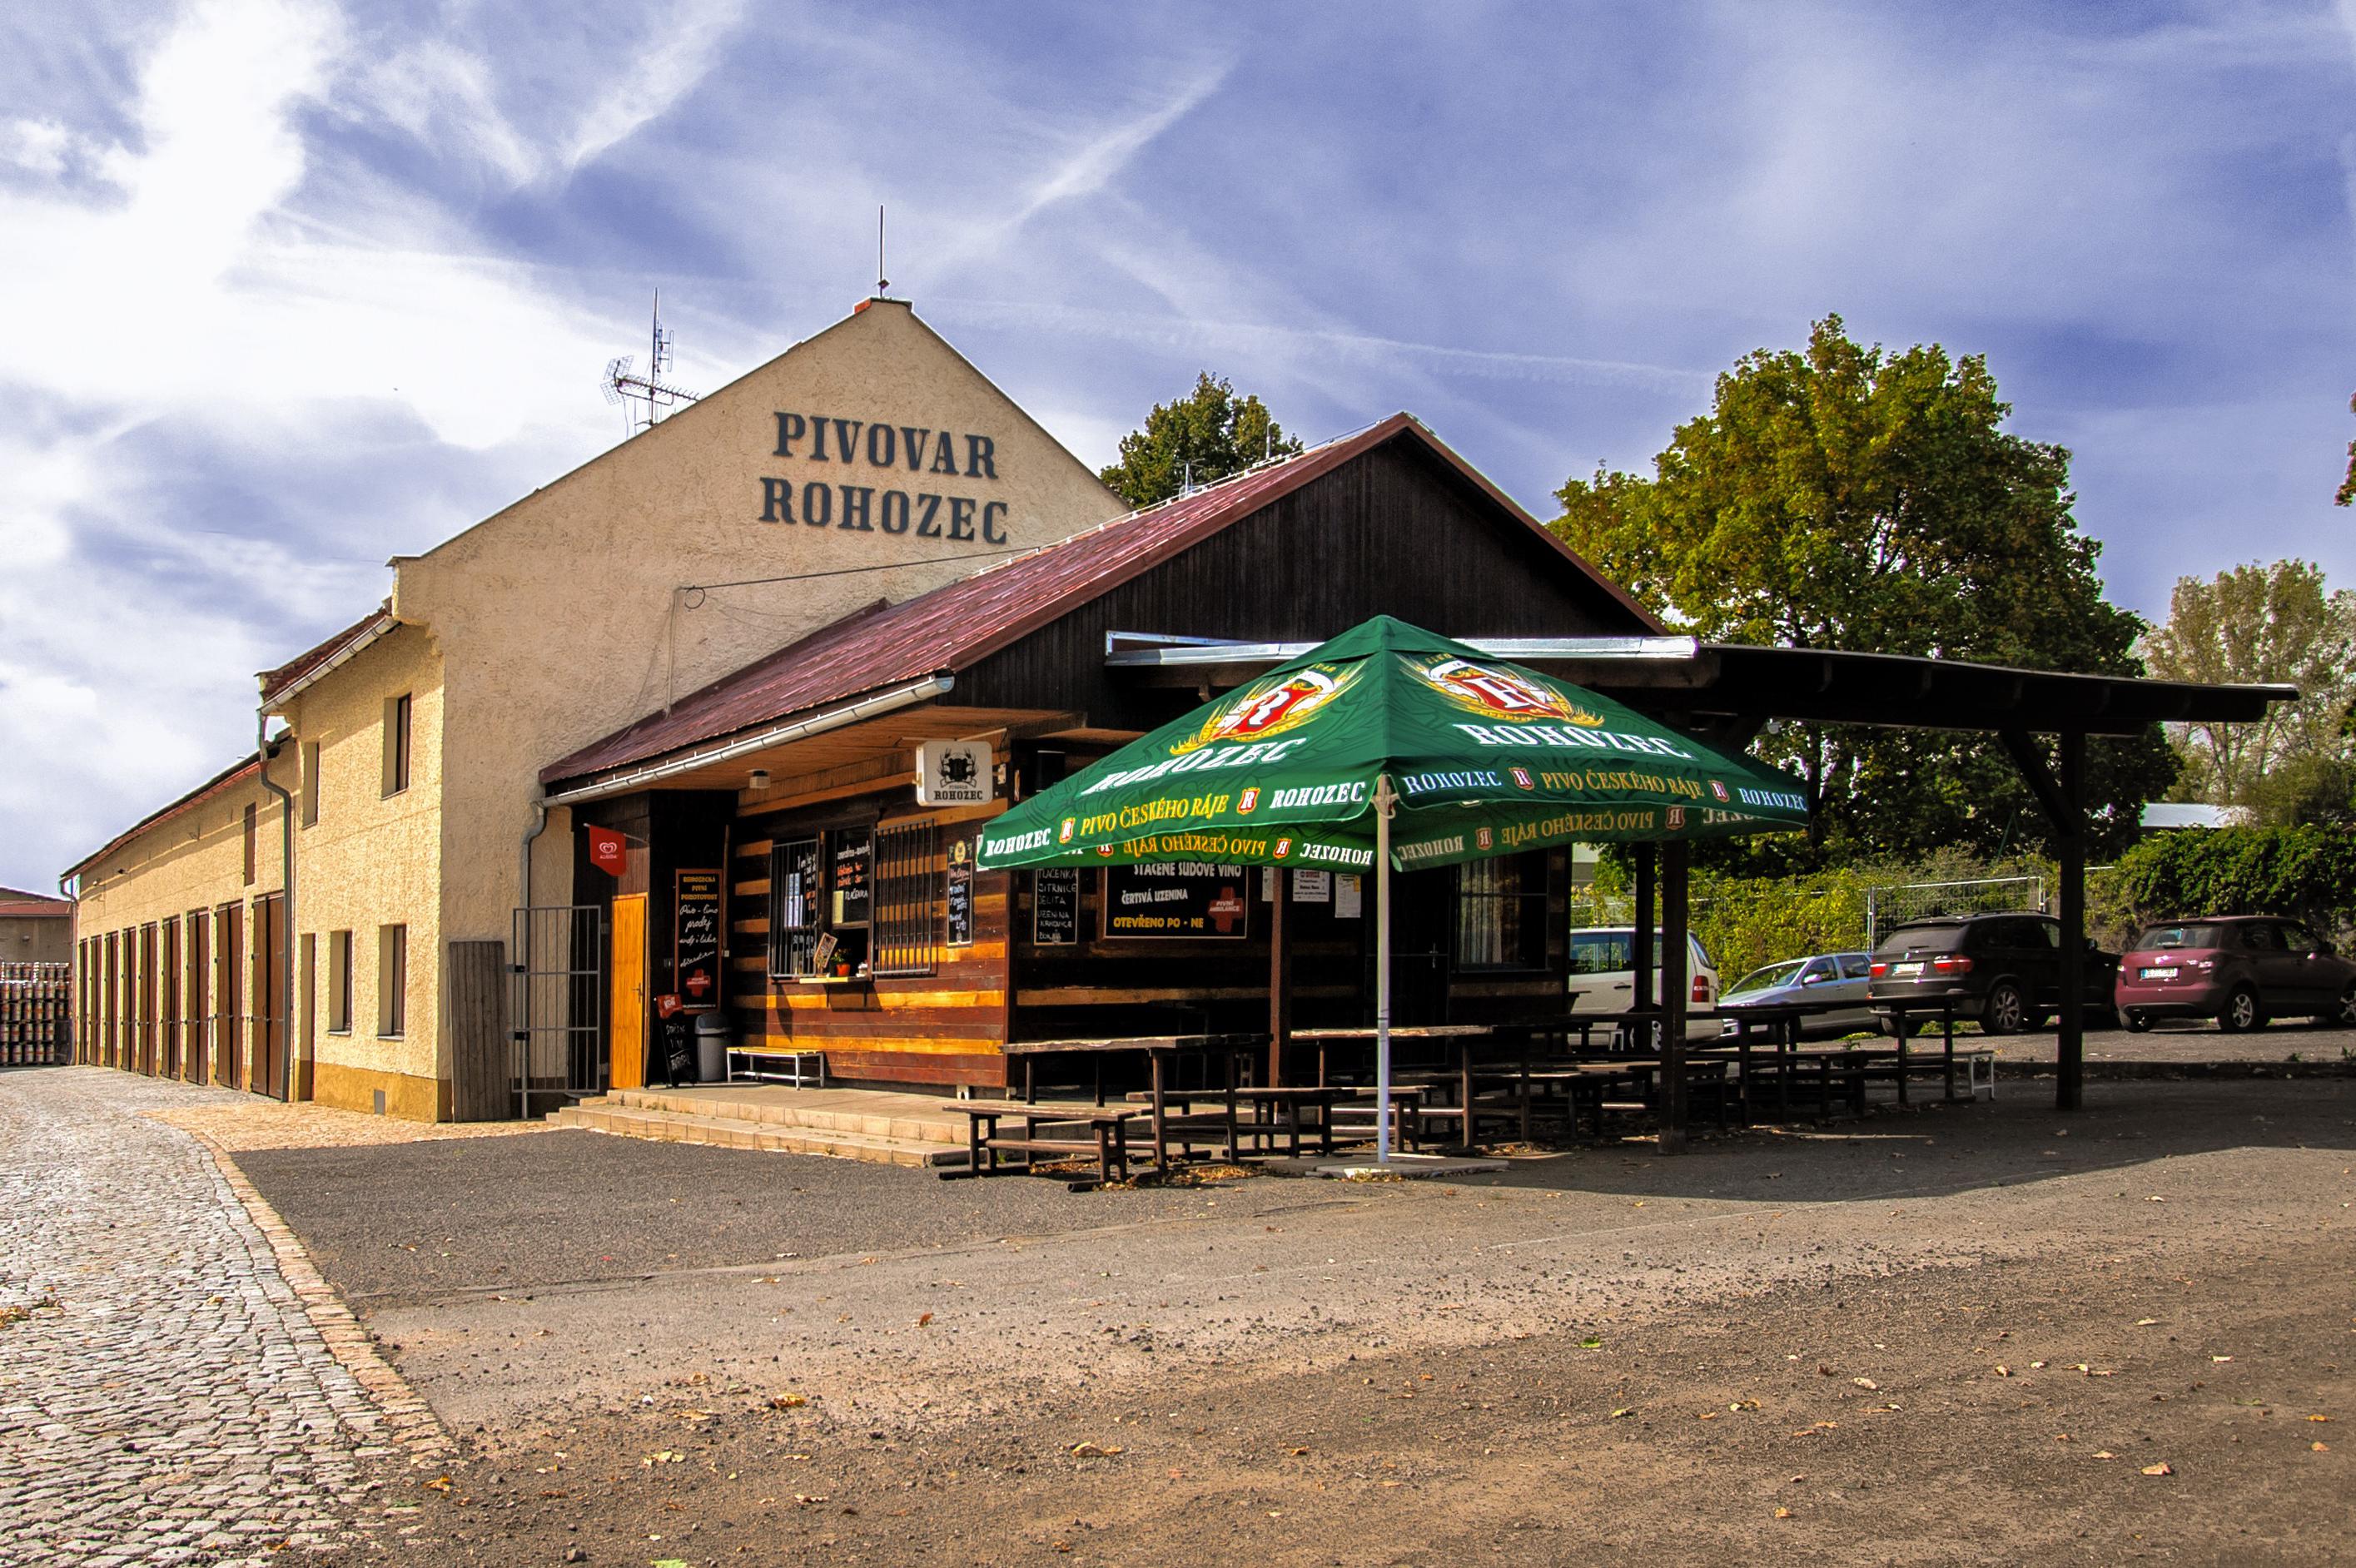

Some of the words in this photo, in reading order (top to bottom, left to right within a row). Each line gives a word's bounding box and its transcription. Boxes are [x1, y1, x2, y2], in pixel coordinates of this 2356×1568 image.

[773, 411, 999, 479] PIVOVAR
[758, 477, 1008, 545] ROHOZEC
[1452, 723, 1695, 759] ROHOZEC
[1081, 738, 1307, 796] ROHOZEC
[933, 790, 983, 800] ROHOZEC
[1402, 771, 1503, 794] ROHOZEC
[1541, 772, 1583, 790] PIVO
[1586, 769, 1665, 793] ČESKÉHO
[1666, 776, 1705, 799] RÁJE
[1738, 787, 1808, 811] ROHOZEC
[984, 828, 1051, 856] ROHOZEC
[1080, 812, 1117, 836] PIVO
[1120, 797, 1189, 829] ČESKÉHO
[1190, 793, 1230, 819] RÁJE
[1269, 782, 1367, 809] ROHOZEC
[1155, 889, 1189, 902] UZENINA
[1113, 914, 1165, 928] OTEVŘENO
[1167, 917, 1180, 928] PO
[1190, 917, 1204, 928] NE
